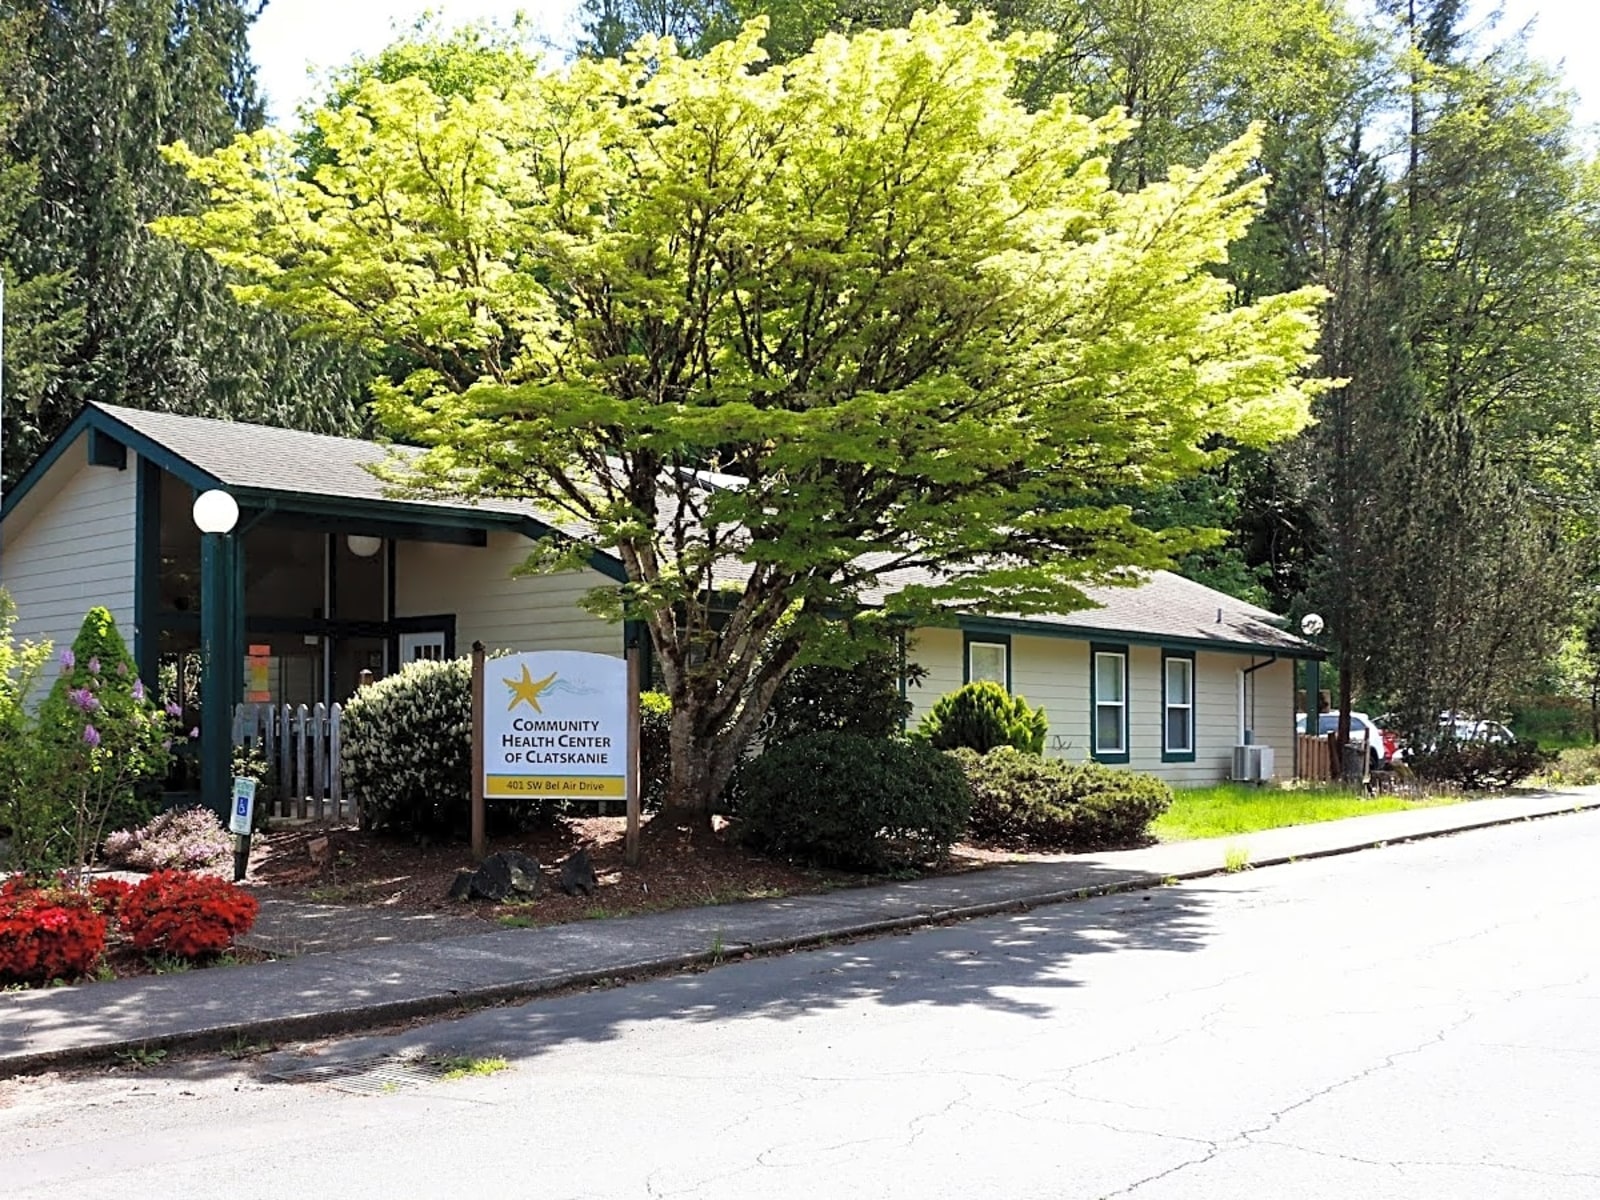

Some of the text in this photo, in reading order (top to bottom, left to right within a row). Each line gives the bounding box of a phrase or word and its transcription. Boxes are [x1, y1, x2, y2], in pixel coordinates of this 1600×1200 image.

[513, 718, 600, 731] COMMUNITY
[502, 734, 611, 747] HEALTH CENTER
[504, 750, 608, 763] OF CLATSKANIE
[506, 780, 605, 791] 401 SW Bel Air Drive
